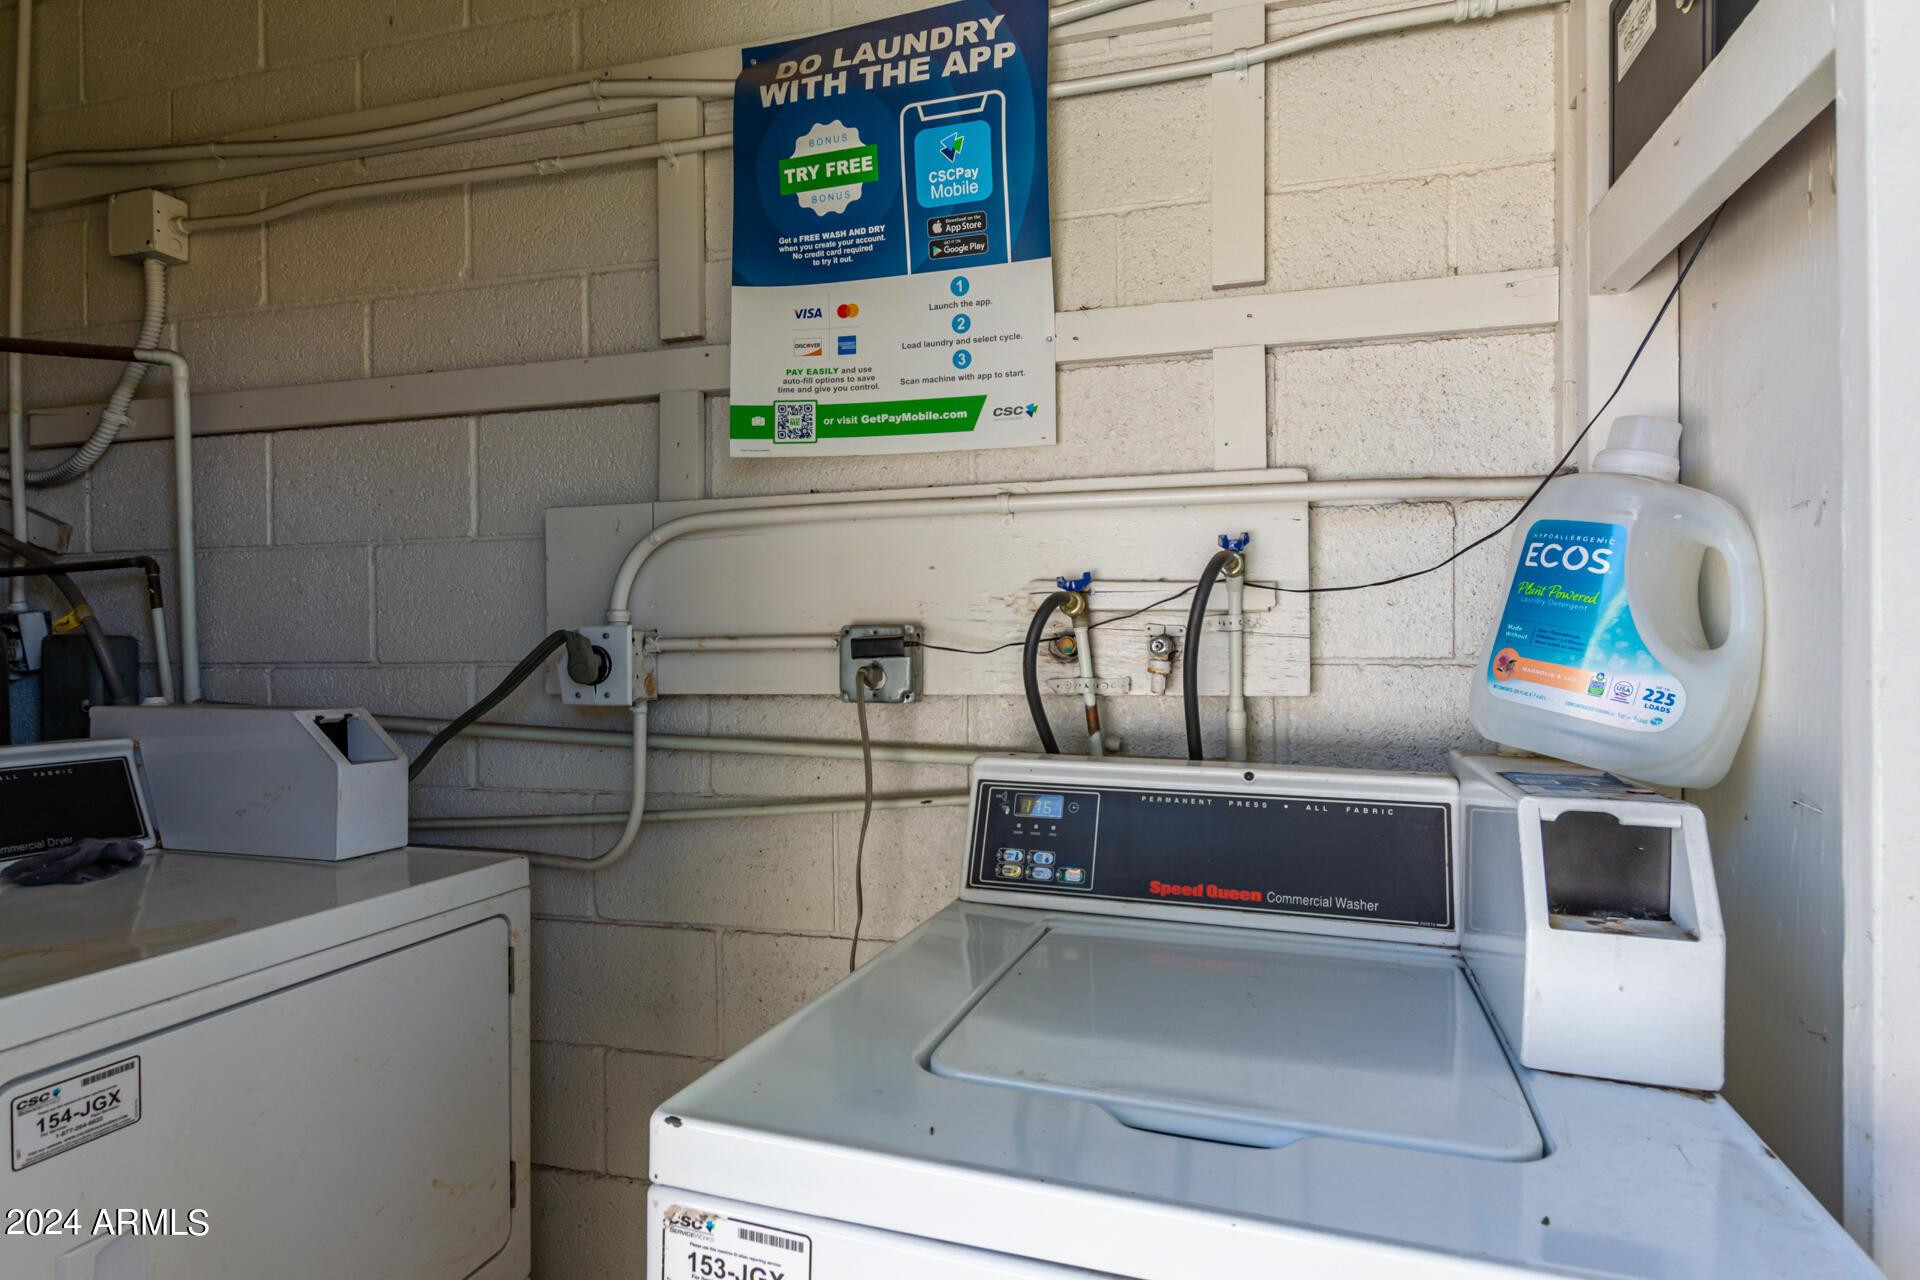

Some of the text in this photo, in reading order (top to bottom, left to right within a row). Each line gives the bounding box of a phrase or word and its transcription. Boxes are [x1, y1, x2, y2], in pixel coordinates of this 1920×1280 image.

[776, 14, 1005, 80] DO LAUNDRY
[760, 42, 1016, 108] WITH THE APP
[808, 133, 848, 147] BONUS
[784, 156, 873, 184] TRY FREE
[928, 167, 979, 183] CSCPay
[931, 180, 979, 199] Mobile
[811, 190, 850, 204] BONUS
[945, 215, 966, 223] Download
[945, 221, 982, 233] App Store
[779, 237, 791, 245] Get
[799, 233, 820, 242] FREE
[822, 229, 847, 240] WASH
[848, 227, 866, 237] AND
[868, 224, 886, 234] DRY
[779, 234, 886, 253] when you create your account.
[944, 242, 985, 254] Google Play
[792, 244, 873, 260] No credit card required
[821, 258, 831, 266] try
[839, 255, 853, 263] out.
[956, 280, 963, 292] 1
[928, 298, 993, 311] Launch the app.
[793, 307, 822, 319] VISA
[957, 317, 965, 330] 2
[902, 332, 1024, 350] Load laundry and select cycle.
[957, 353, 965, 366] 3
[786, 366, 872, 376] PAY EASILY and use
[900, 369, 1026, 386] Scan machine with app to start.
[783, 377, 813, 385] auto-fill
[815, 375, 845, 385] options
[778, 386, 795, 394] time
[814, 385, 831, 394] give
[833, 384, 848, 394] you
[850, 382, 880, 391] control.
[823, 410, 968, 426] or visit GetPayMobile.com
[993, 406, 1024, 417] CSC
[1533, 533, 1616, 546] HYPOALLERGENIC
[1525, 542, 1614, 574] ECOS
[1517, 580, 1601, 605] Plant Powered
[1548, 598, 1588, 612] Detergent
[1616, 685, 1631, 694] USA
[1642, 688, 1676, 707] 225
[1644, 703, 1671, 714] LOADS
[1141, 795, 1394, 815] PERMANENT PRESS ALL FABRIC
[47, 836, 73, 848] Dryer
[1149, 880, 1379, 911] Speed Queen Commercial Washer
[16, 1092, 50, 1110] CSC
[36, 1089, 121, 1133] 154-JGX
